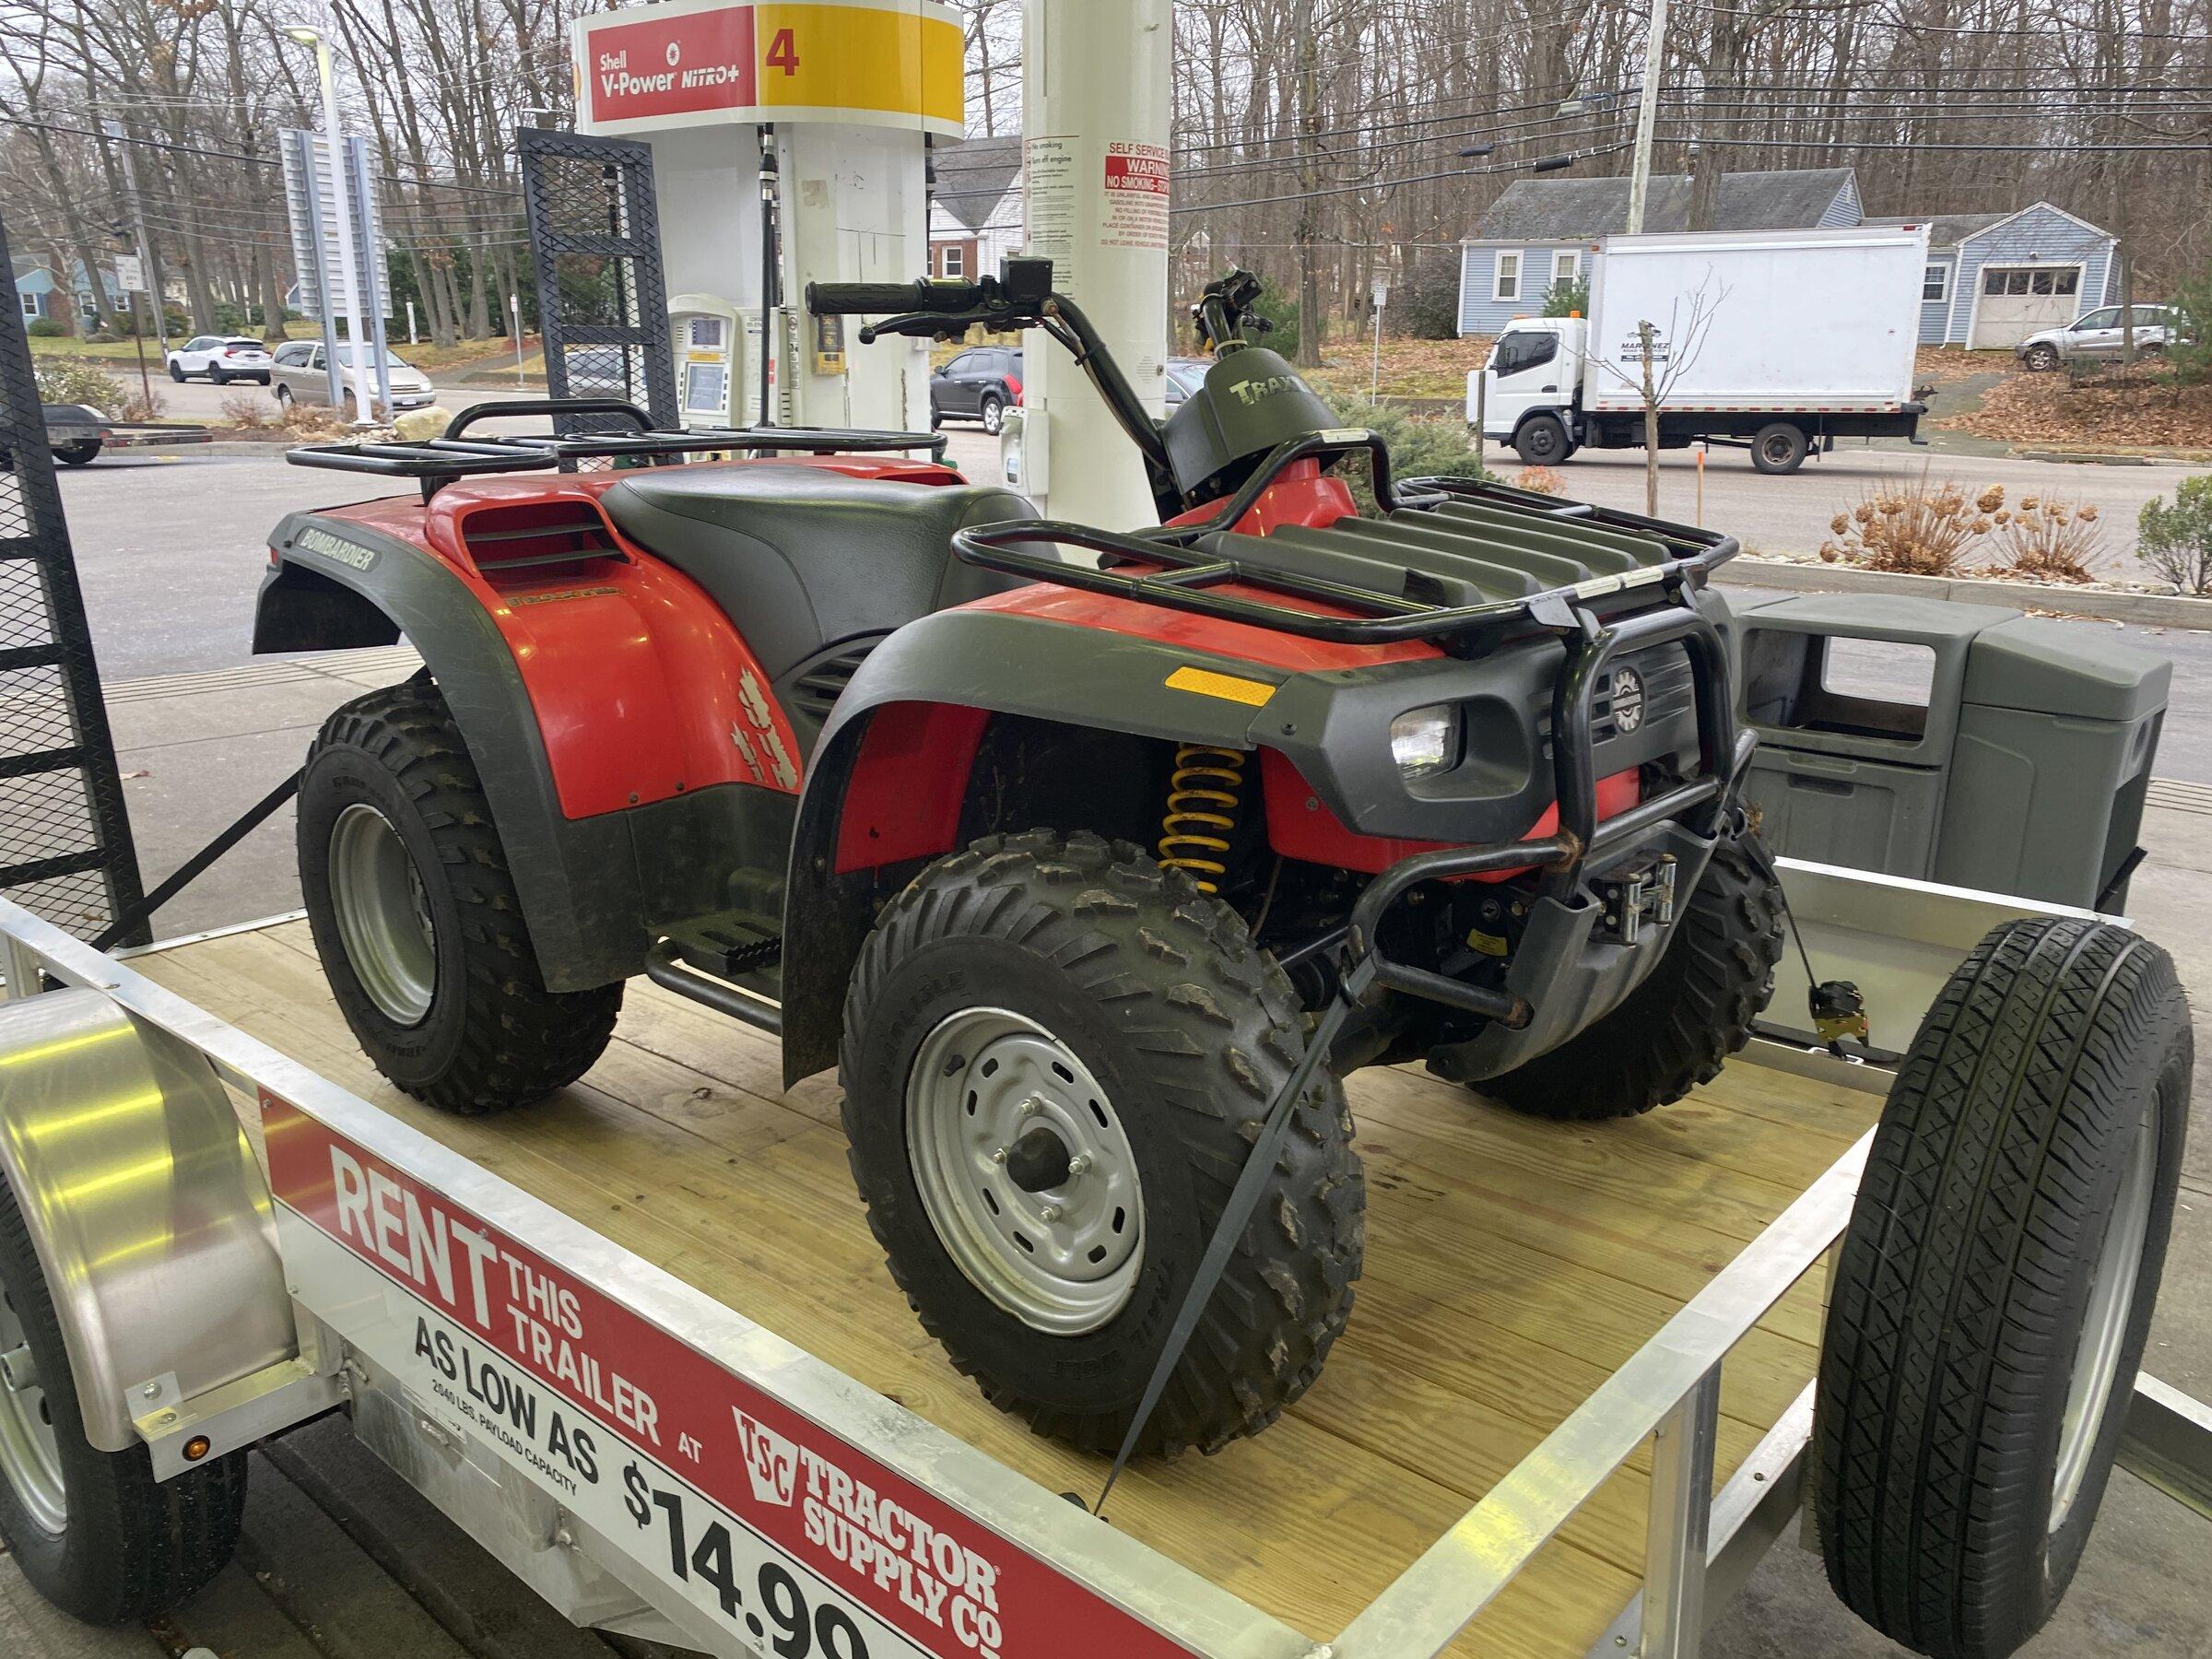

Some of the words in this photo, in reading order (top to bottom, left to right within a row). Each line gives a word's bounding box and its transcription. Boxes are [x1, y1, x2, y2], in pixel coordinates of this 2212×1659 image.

[600, 50, 627, 71] Shell
[601, 72, 675, 98] V-Power
[766, 29, 800, 76] 4
[1040, 141, 1062, 150] smoking
[1109, 142, 1134, 154] SELF
[1126, 159, 1170, 177] WARN
[1107, 175, 1121, 188] NO
[299, 529, 376, 571] BOMBARDIER
[329, 1143, 498, 1330] RENT
[500, 1250, 583, 1340] THIS
[415, 1315, 457, 1381] AS
[462, 1345, 536, 1441] LOW
[547, 1410, 599, 1485] AS
[506, 1303, 662, 1447] TRAILER
[677, 1431, 703, 1465] AT
[431, 1379, 455, 1406] 2040
[479, 1413, 523, 1455] PAYLOAD
[524, 1448, 578, 1497] CAPACITY
[740, 1414, 790, 1502] TSC
[798, 1444, 1000, 1615] TRACTOR
[802, 1496, 948, 1629] SUPPLY
